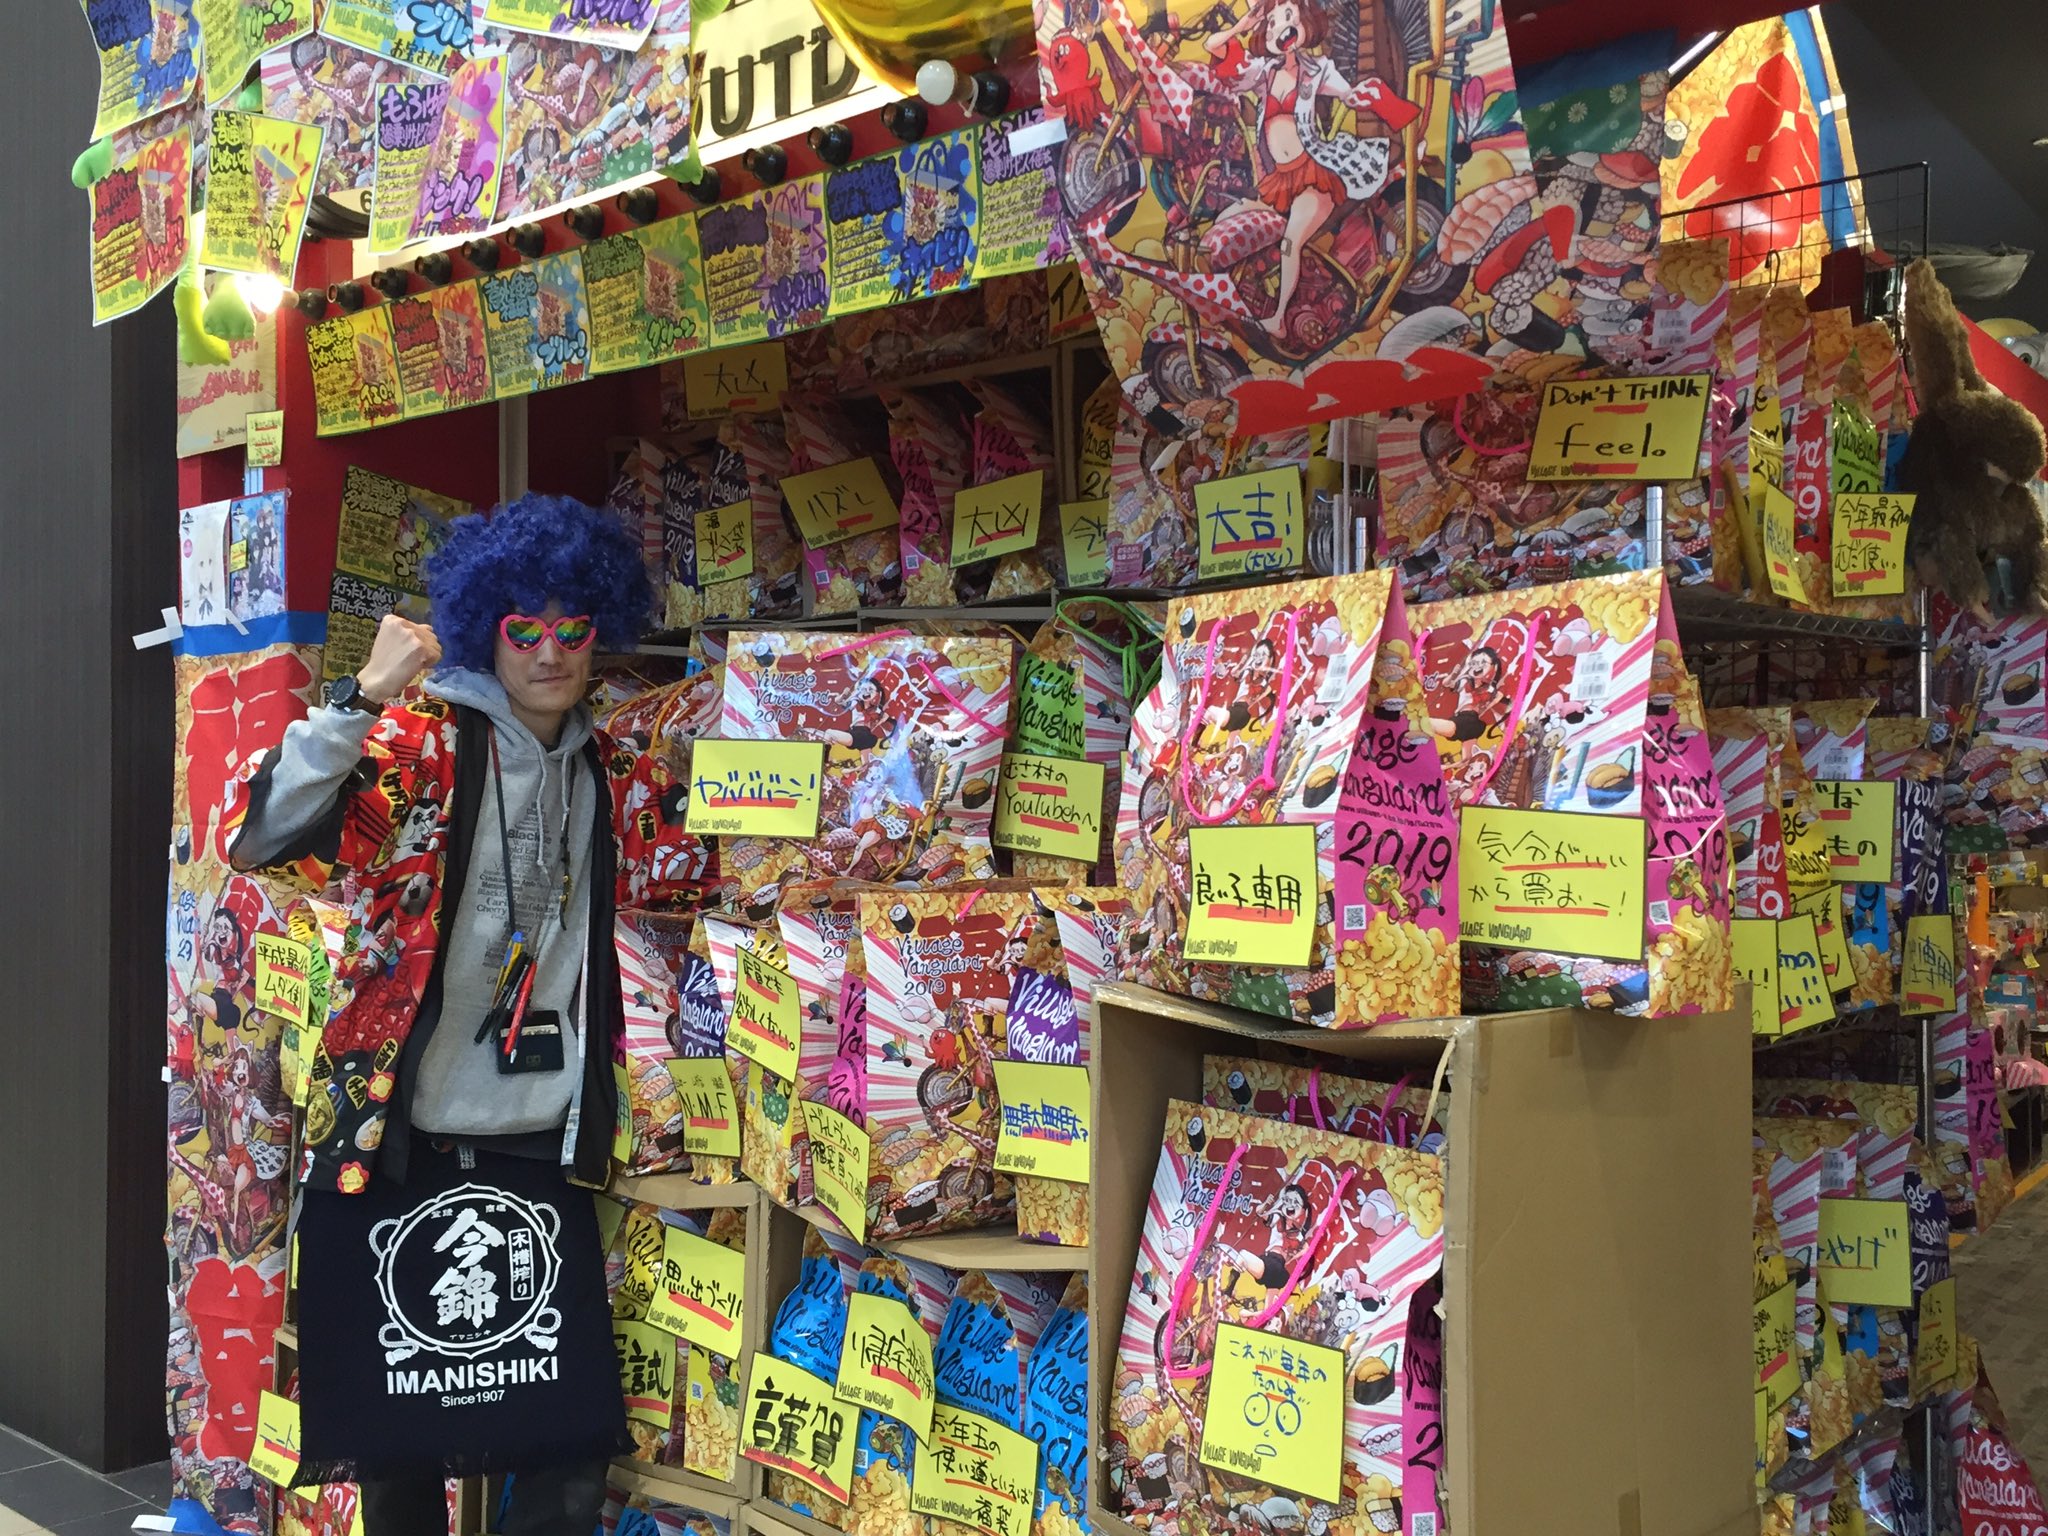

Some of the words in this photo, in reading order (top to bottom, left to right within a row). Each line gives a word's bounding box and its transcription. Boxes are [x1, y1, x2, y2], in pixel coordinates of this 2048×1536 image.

[1627, 381, 1702, 401] THINK
[755, 667, 817, 689] Village
[752, 708, 793, 724] 2019
[1338, 820, 1453, 883] 2019
[896, 933, 963, 956] Village
[899, 951, 984, 981] Vanguard
[904, 979, 947, 997] 2019
[429, 1207, 507, 1329] 今錦
[1229, 1339, 1328, 1383] これが毎年の
[386, 1355, 559, 1395] IMANISHIKI
[441, 1389, 506, 1408] Since1907
[1204, 1440, 1227, 1463] VILLAGE
[1229, 1448, 1263, 1475] VANGUARD
